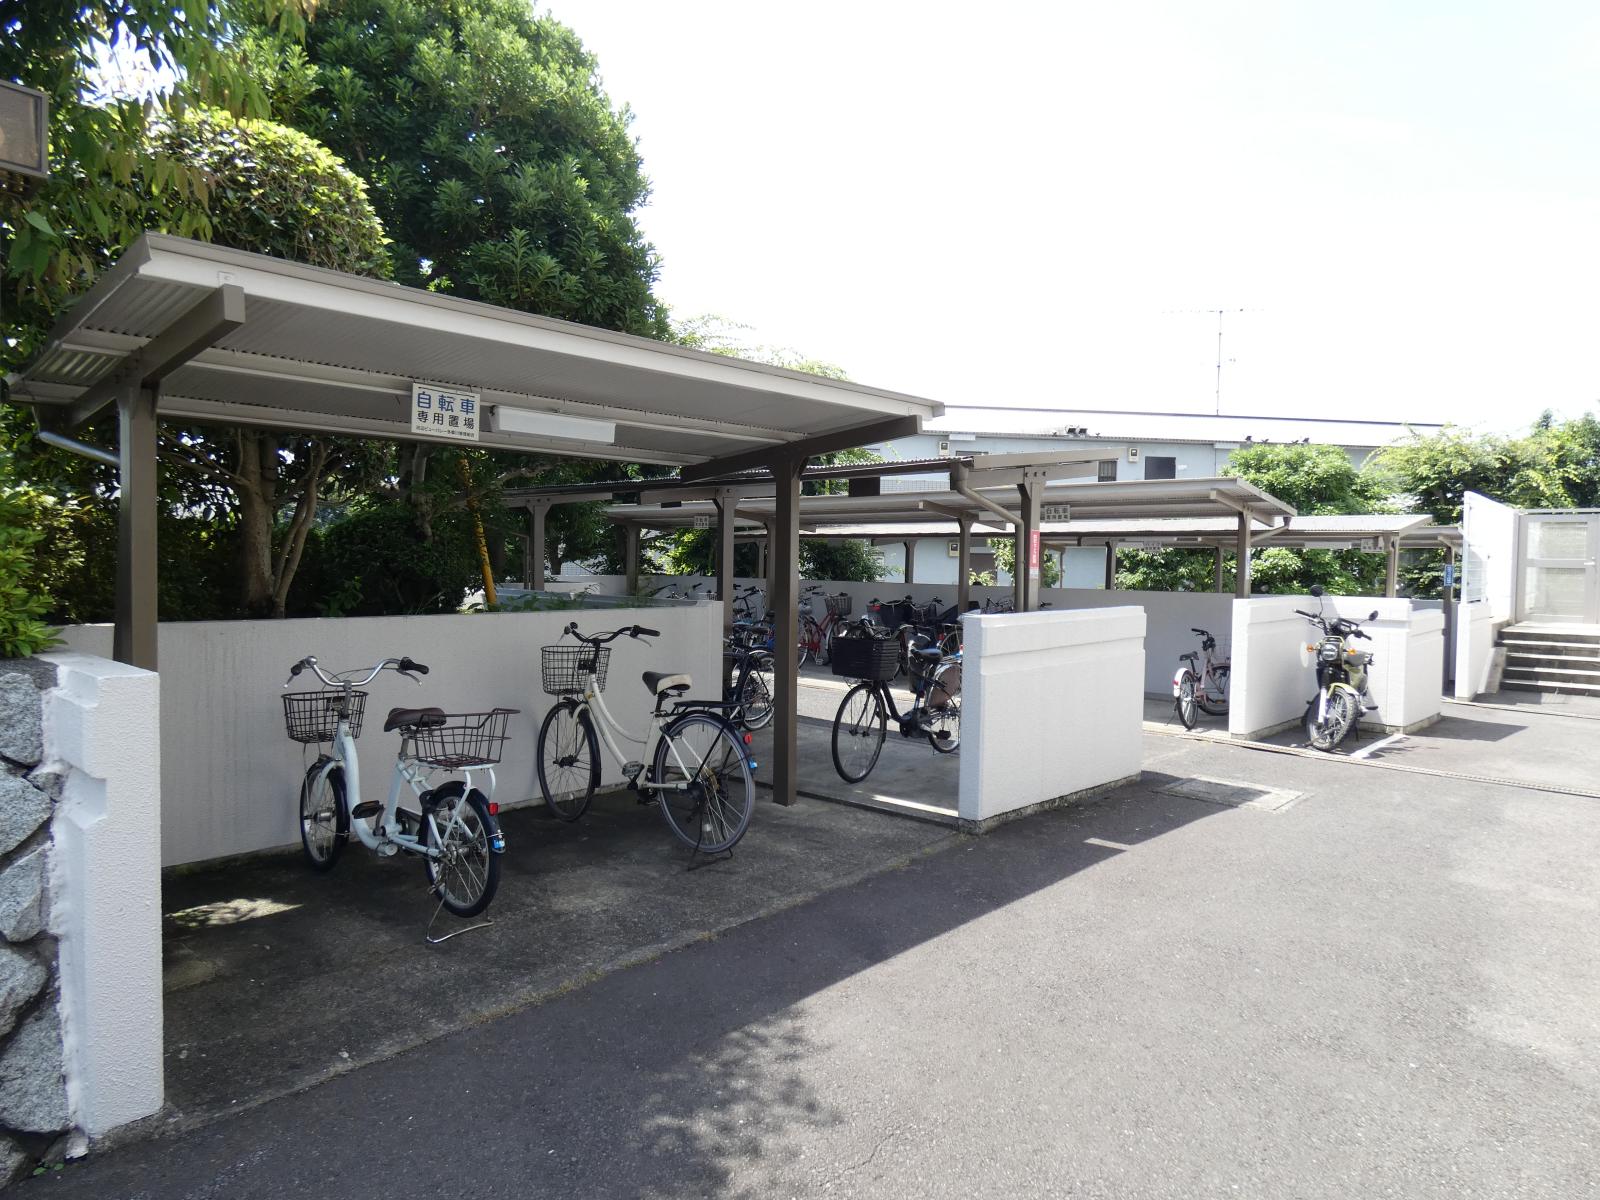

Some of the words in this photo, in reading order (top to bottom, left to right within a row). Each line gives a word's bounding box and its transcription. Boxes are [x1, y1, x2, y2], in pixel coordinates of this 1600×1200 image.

[417, 391, 476, 415] 自転車
[417, 410, 475, 430] 専用置場
